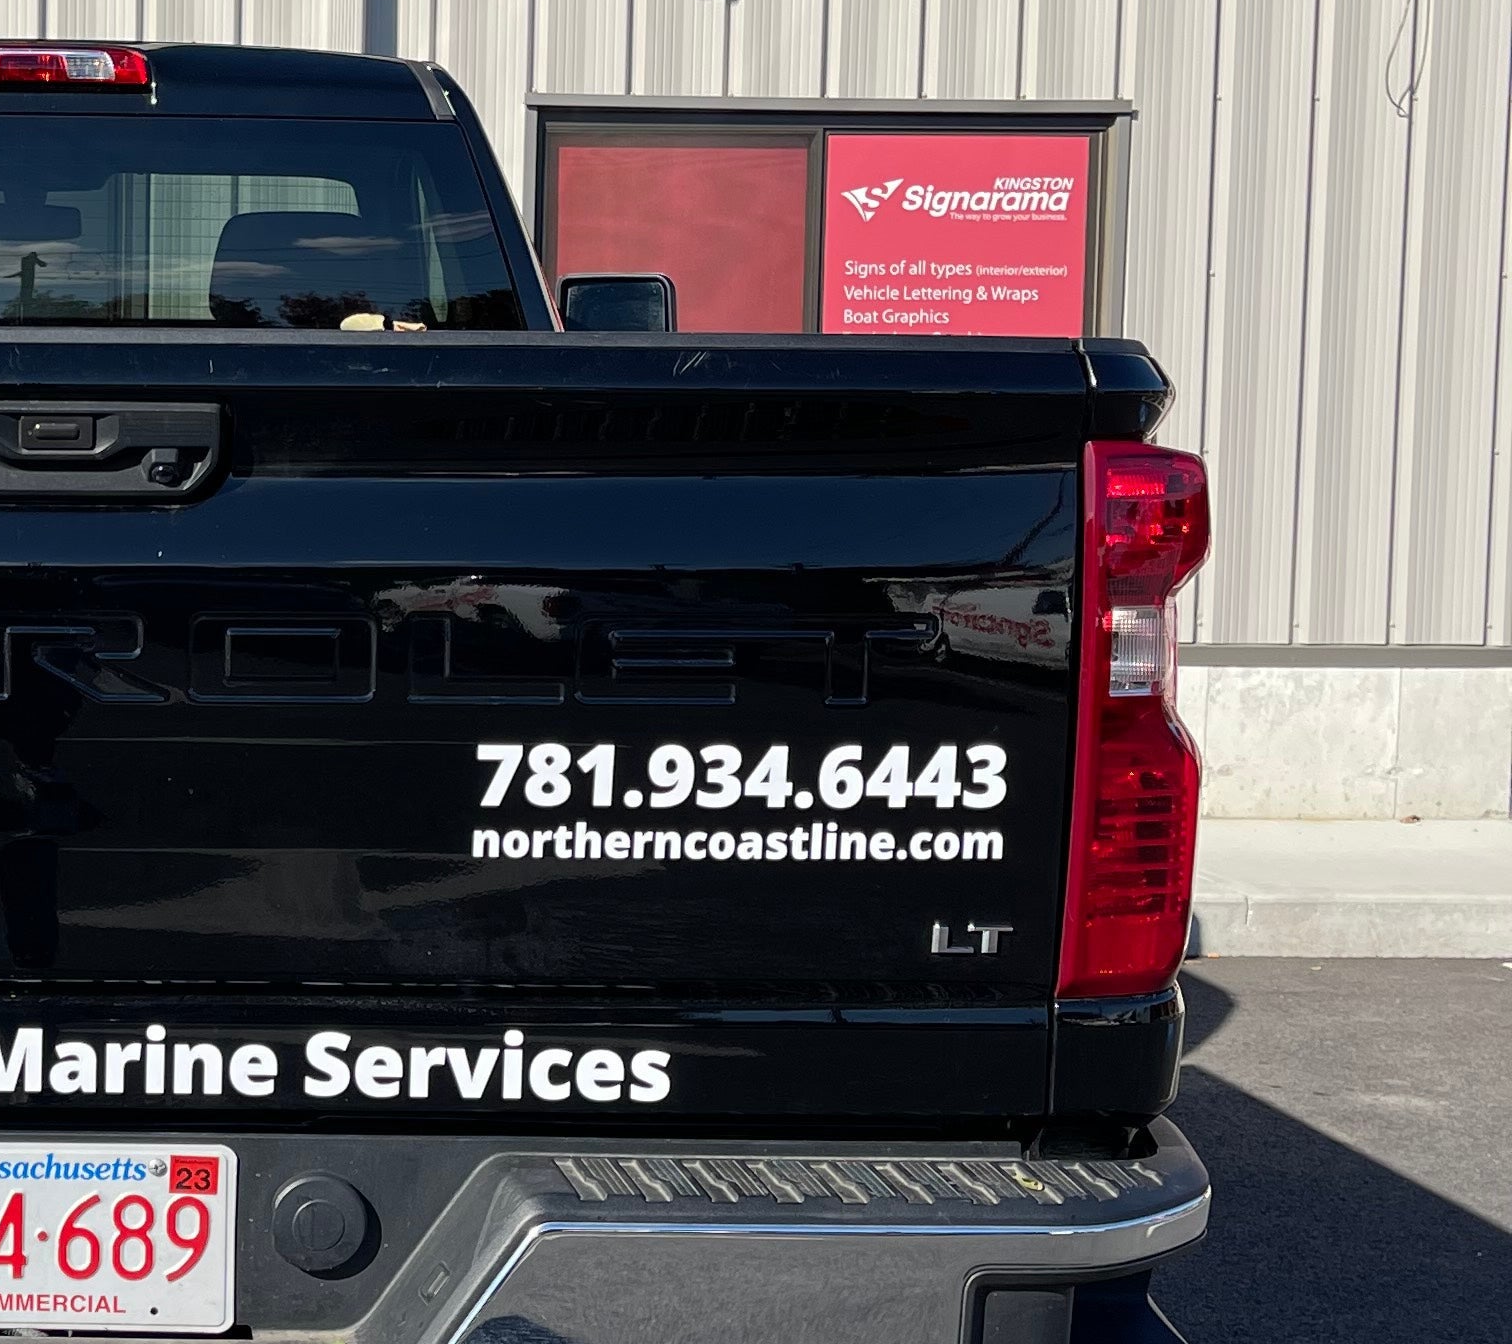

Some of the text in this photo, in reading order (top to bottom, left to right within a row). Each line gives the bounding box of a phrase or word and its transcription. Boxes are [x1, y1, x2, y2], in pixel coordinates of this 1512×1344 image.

[993, 177, 1074, 191] KINGSTON
[901, 184, 1071, 217] Signarama
[950, 212, 964, 220] The
[965, 214, 981, 222] way
[992, 214, 1012, 222] grow
[1013, 214, 1030, 222] your
[844, 260, 1068, 279] Signs of all types (interior/exterior)
[843, 285, 1039, 304] Vehicle Lettering & Wraps
[843, 308, 950, 327] Boat Graphics
[476, 742, 1008, 810] 781.934.6443
[471, 821, 1005, 861] northerncoastline.com
[931, 922, 1014, 954] LT
[303, 1031, 672, 1104] Services
[175, 1167, 211, 1191] 23
